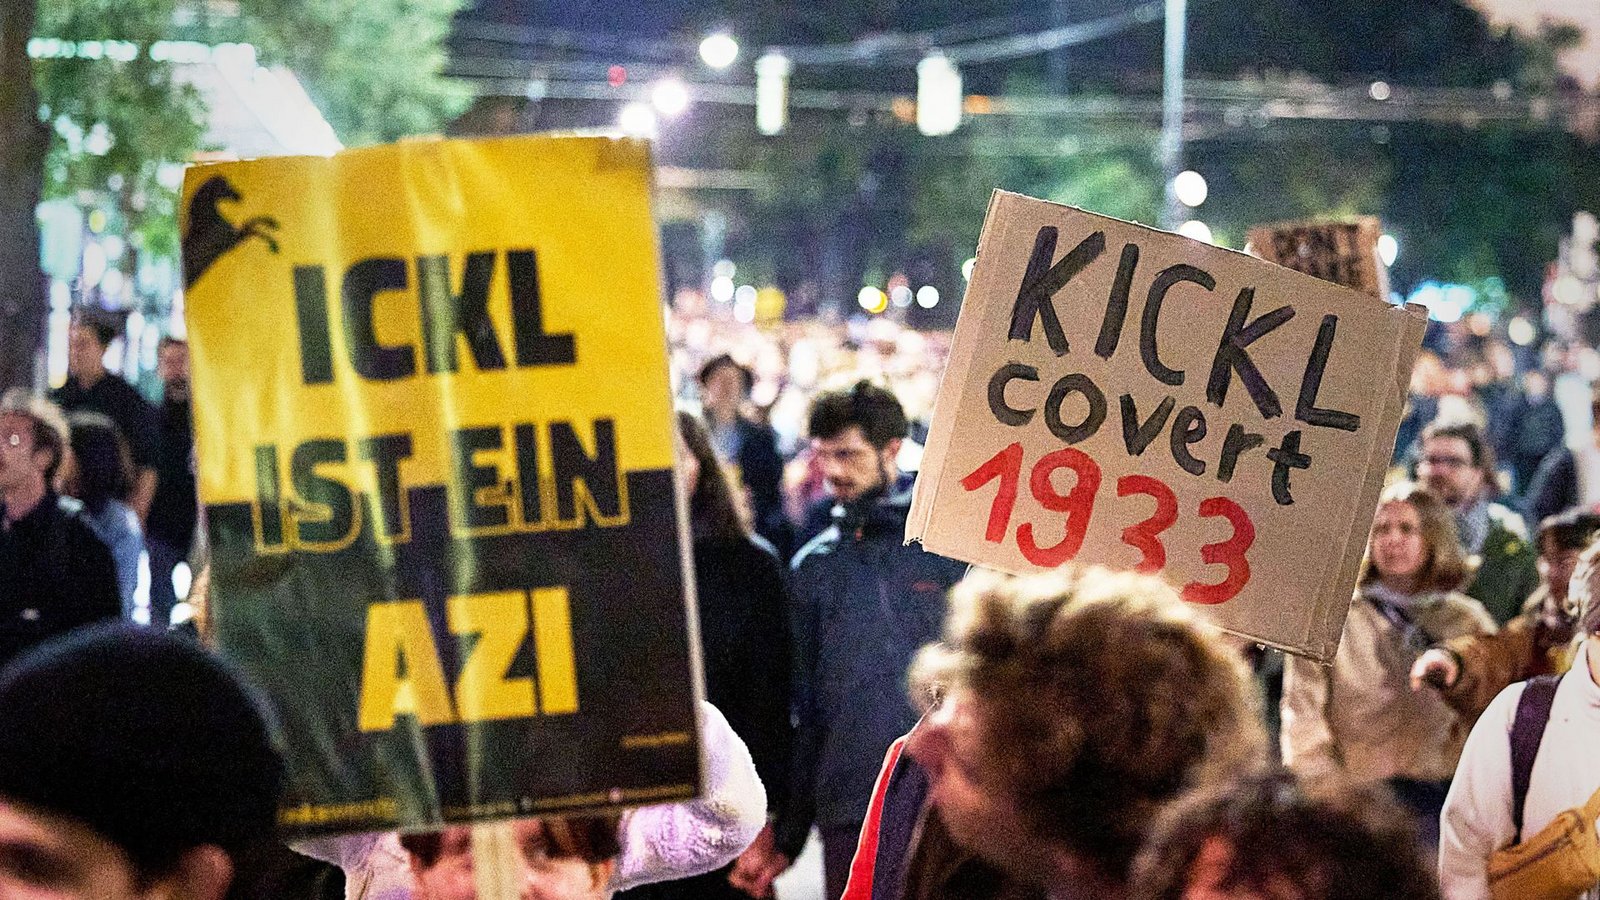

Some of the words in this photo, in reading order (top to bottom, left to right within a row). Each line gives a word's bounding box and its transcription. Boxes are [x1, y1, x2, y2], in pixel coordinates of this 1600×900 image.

[292, 247, 577, 386] ICKL
[1008, 225, 1360, 432] KICKL
[253, 432, 413, 555] IST
[448, 416, 630, 538] EIN
[987, 361, 1311, 505] covert
[958, 441, 1256, 605] 1933
[357, 585, 579, 733] AZI
